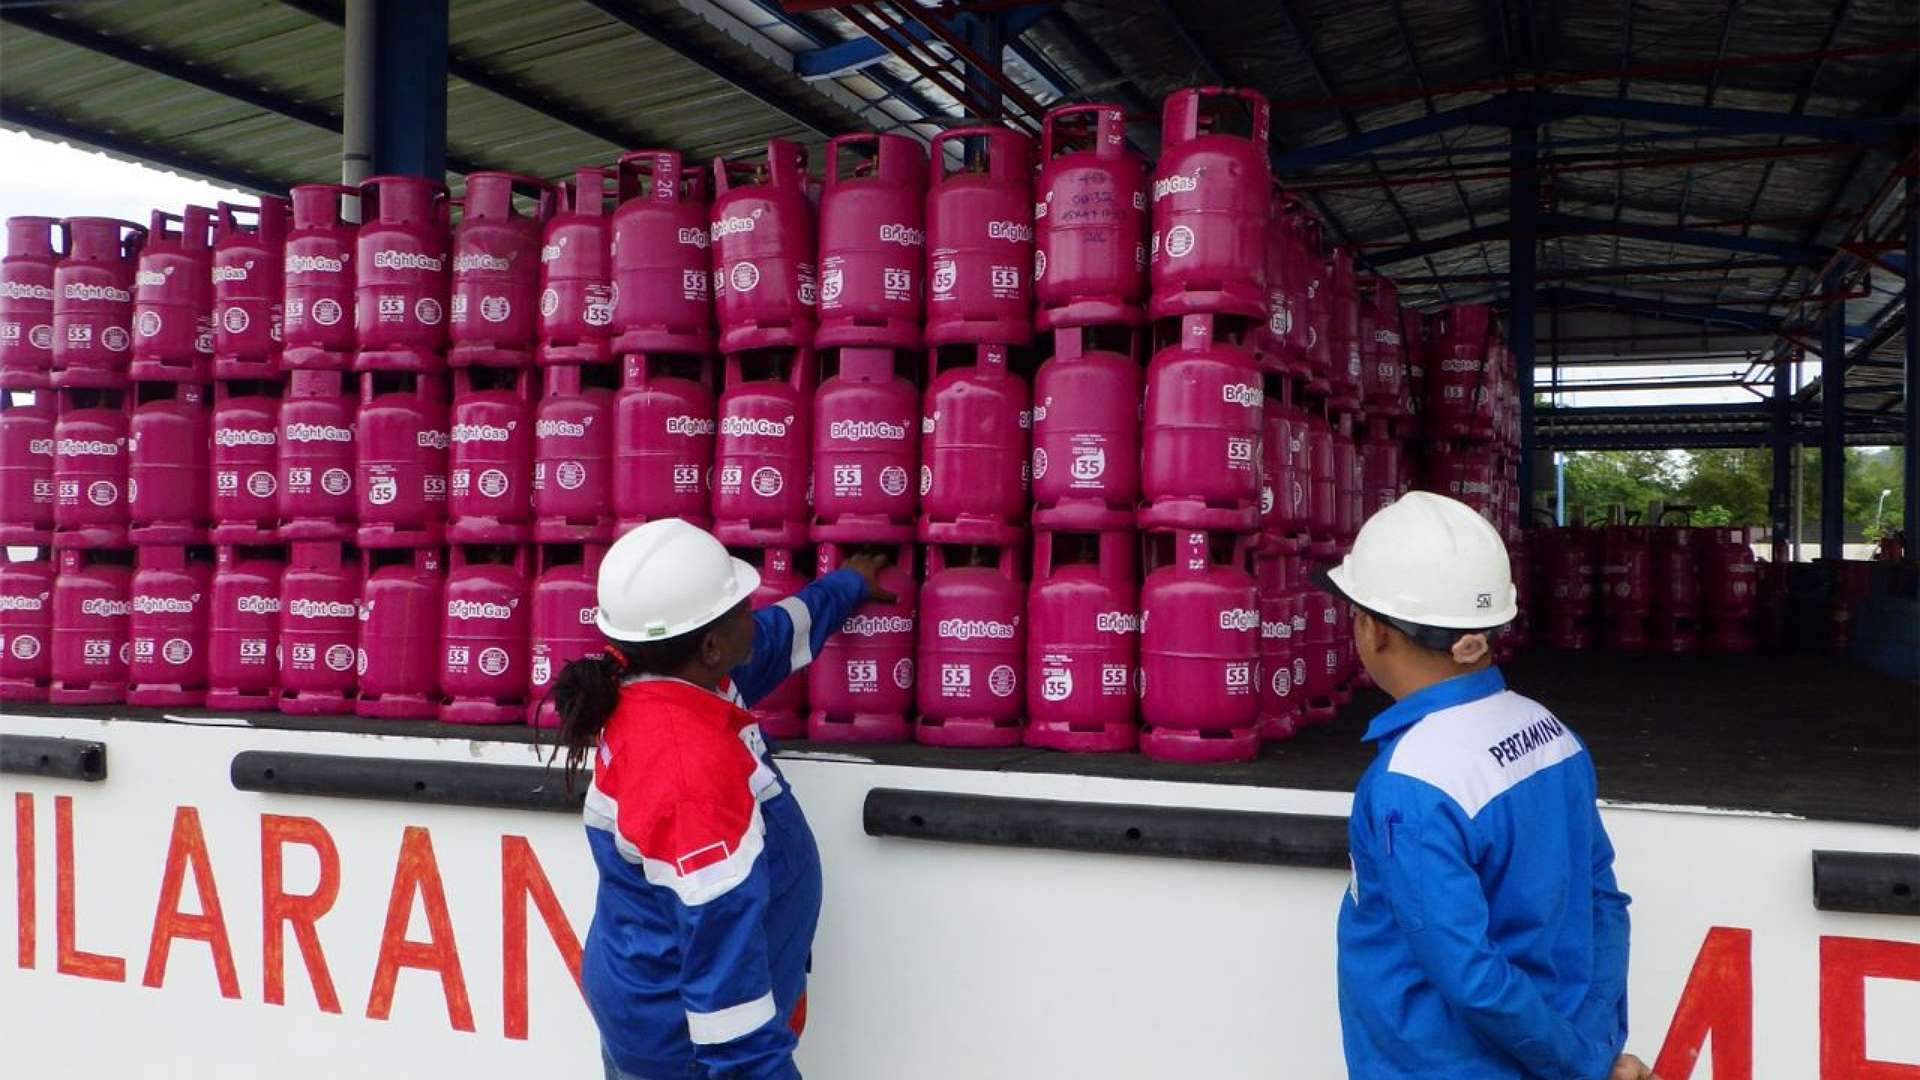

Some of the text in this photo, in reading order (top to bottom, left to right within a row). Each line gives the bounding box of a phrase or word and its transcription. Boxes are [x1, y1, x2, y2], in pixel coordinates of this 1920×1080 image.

[1170, 177, 1195, 192] Gas
[730, 217, 754, 231] Gas
[315, 256, 341, 272] Gas
[376, 252, 441, 271] Bright Gas
[225, 266, 246, 280] Gas
[65, 284, 129, 301] Bright Gas
[585, 308, 609, 321] 135
[288, 424, 350, 442] Bright Gas
[482, 426, 508, 441] Gas
[558, 422, 583, 436] Gas
[668, 416, 706, 436] Bright
[723, 417, 784, 436] Bright Gas
[832, 420, 875, 440] Bright
[876, 422, 904, 438] Gas
[216, 429, 275, 446] Bright Gas
[90, 443, 117, 455] Gas
[1073, 460, 1100, 474] 135
[16, 597, 41, 610] Gas
[83, 599, 122, 616] Bright
[167, 598, 192, 612] Gas
[239, 597, 280, 614] Bright
[291, 600, 354, 618] Bright Gas
[449, 600, 510, 619] Bright Gas
[843, 616, 912, 636] Bright Gas
[940, 619, 1013, 640] Bright Gas
[850, 666, 871, 680] 55
[945, 669, 964, 683] 55
[1043, 682, 1067, 695] 135
[1488, 718, 1563, 768] PERTAMINA
[16, 792, 592, 1040] ILARAN
